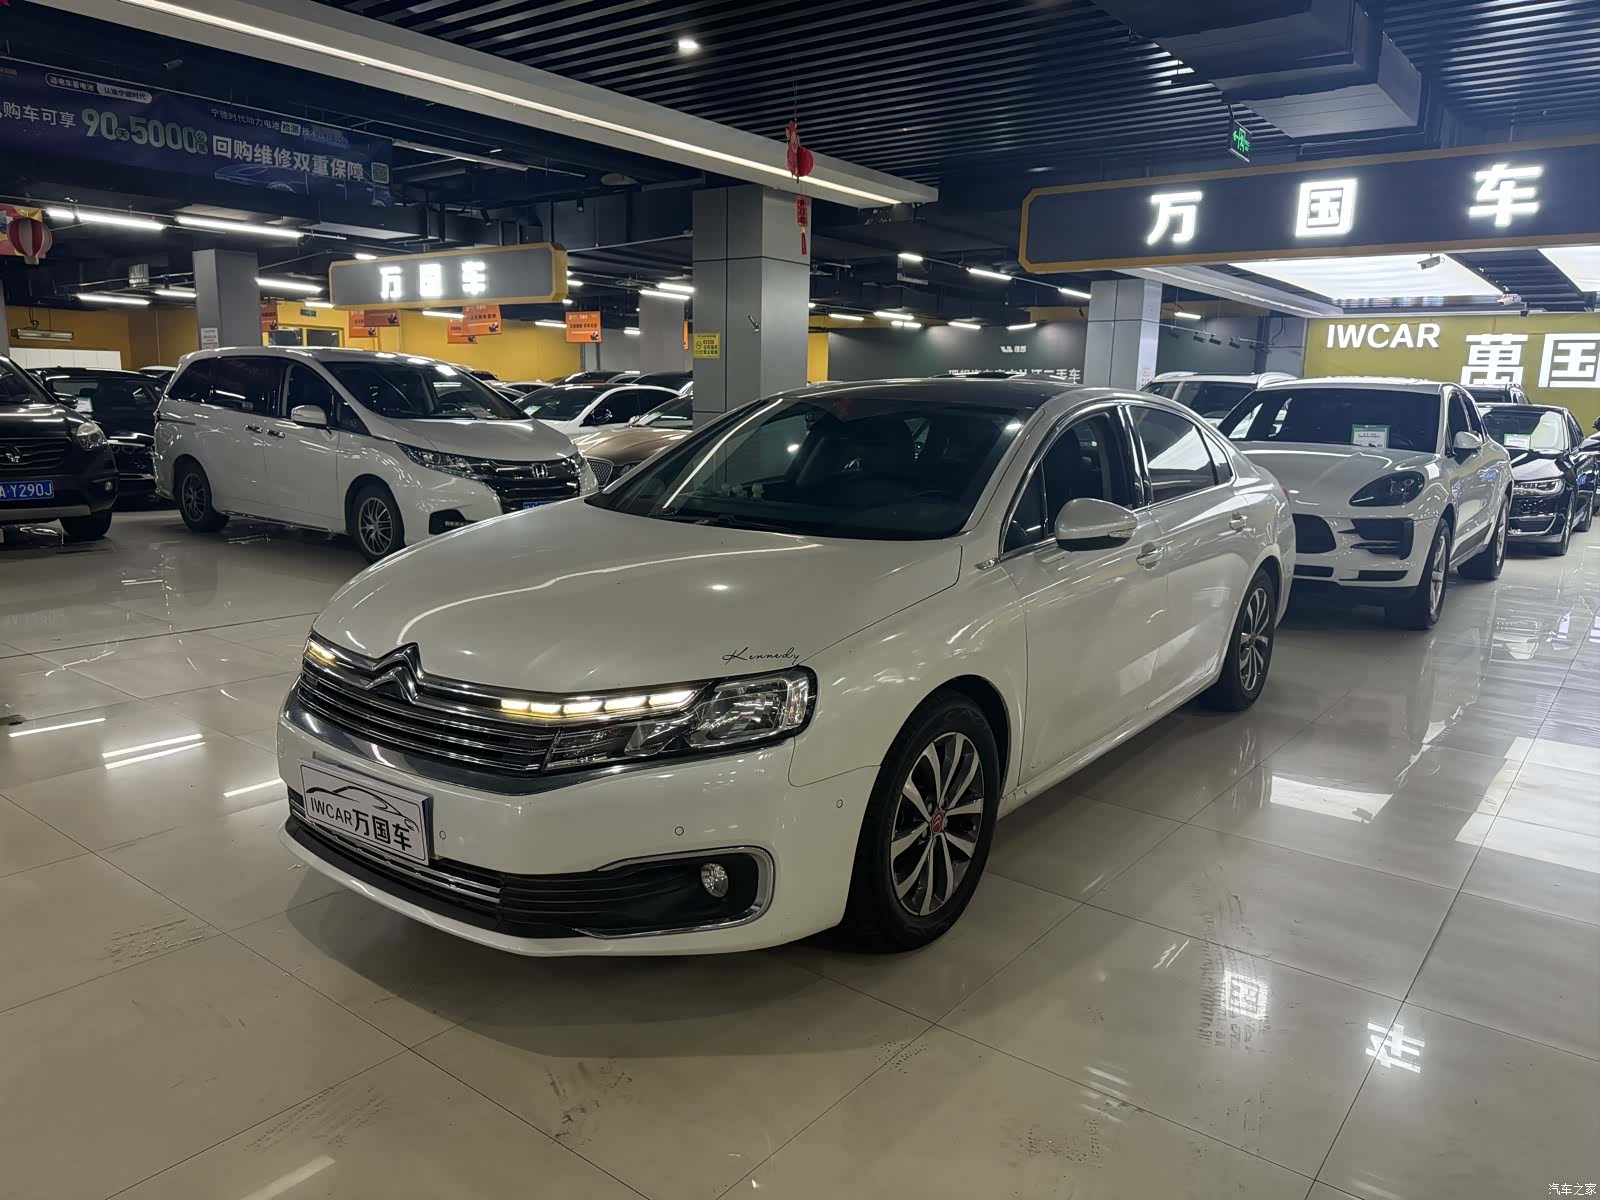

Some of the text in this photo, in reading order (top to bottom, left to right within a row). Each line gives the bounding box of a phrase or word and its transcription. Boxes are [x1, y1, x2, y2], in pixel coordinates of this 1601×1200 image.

[1147, 163, 1543, 245] 万国车
[1327, 323, 1441, 348] IWCAR
[722, 646, 800, 666] Kennedy
